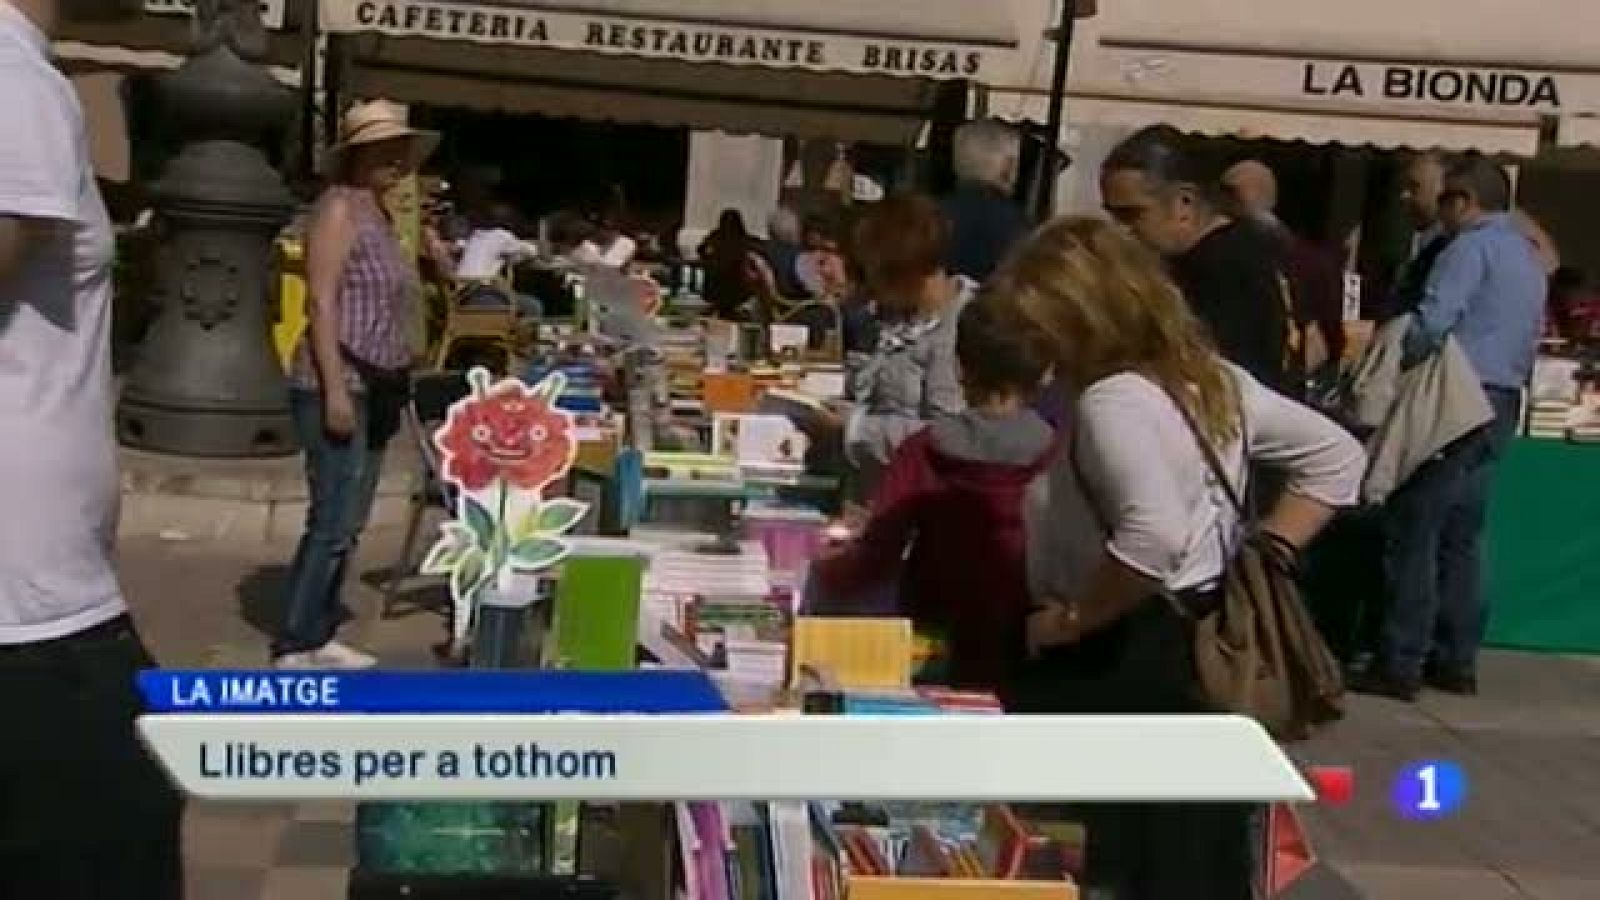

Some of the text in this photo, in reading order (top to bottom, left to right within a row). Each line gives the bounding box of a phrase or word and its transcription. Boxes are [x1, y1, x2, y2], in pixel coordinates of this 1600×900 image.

[355, 1, 981, 75] CAFETERIA RESTAURANTE BRISAS
[1302, 62, 1561, 107] LA BIONDA
